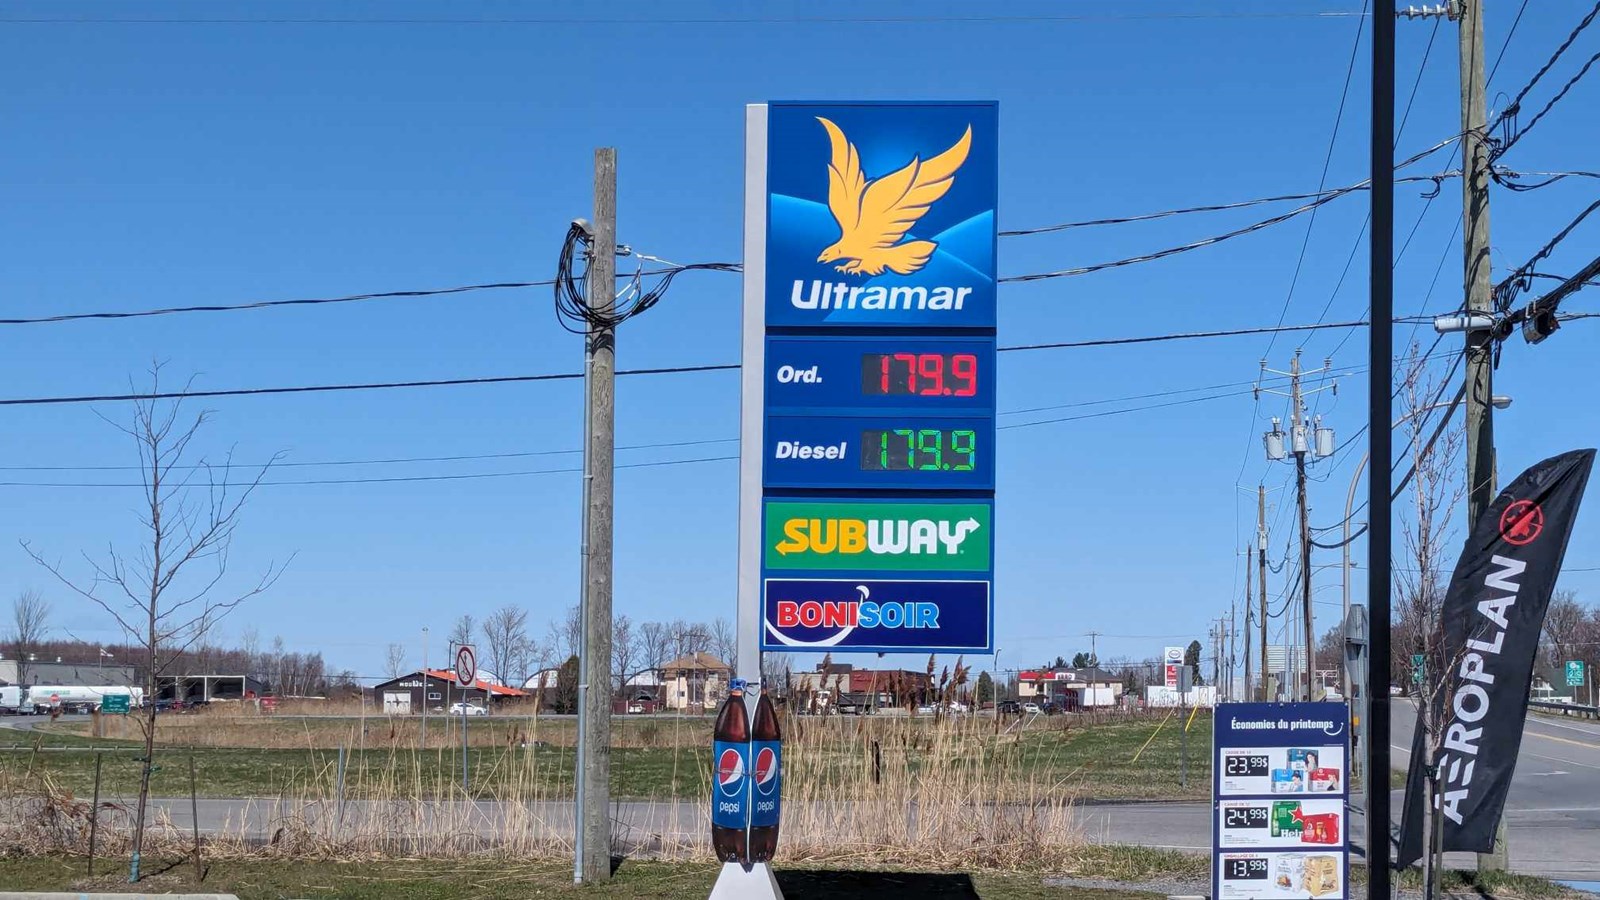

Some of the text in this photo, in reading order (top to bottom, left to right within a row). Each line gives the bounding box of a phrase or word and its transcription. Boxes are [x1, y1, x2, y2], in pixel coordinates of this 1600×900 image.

[791, 279, 972, 310] Ultramar
[776, 354, 977, 396] Ord. 179.9
[775, 429, 976, 470] Diesel 179.9
[775, 517, 980, 556] SUBWAY
[1434, 554, 1527, 825] AEROPLAN
[1231, 716, 1334, 732] Économies du printemps
[719, 801, 740, 814] pepsi
[757, 799, 774, 813] pepsi
